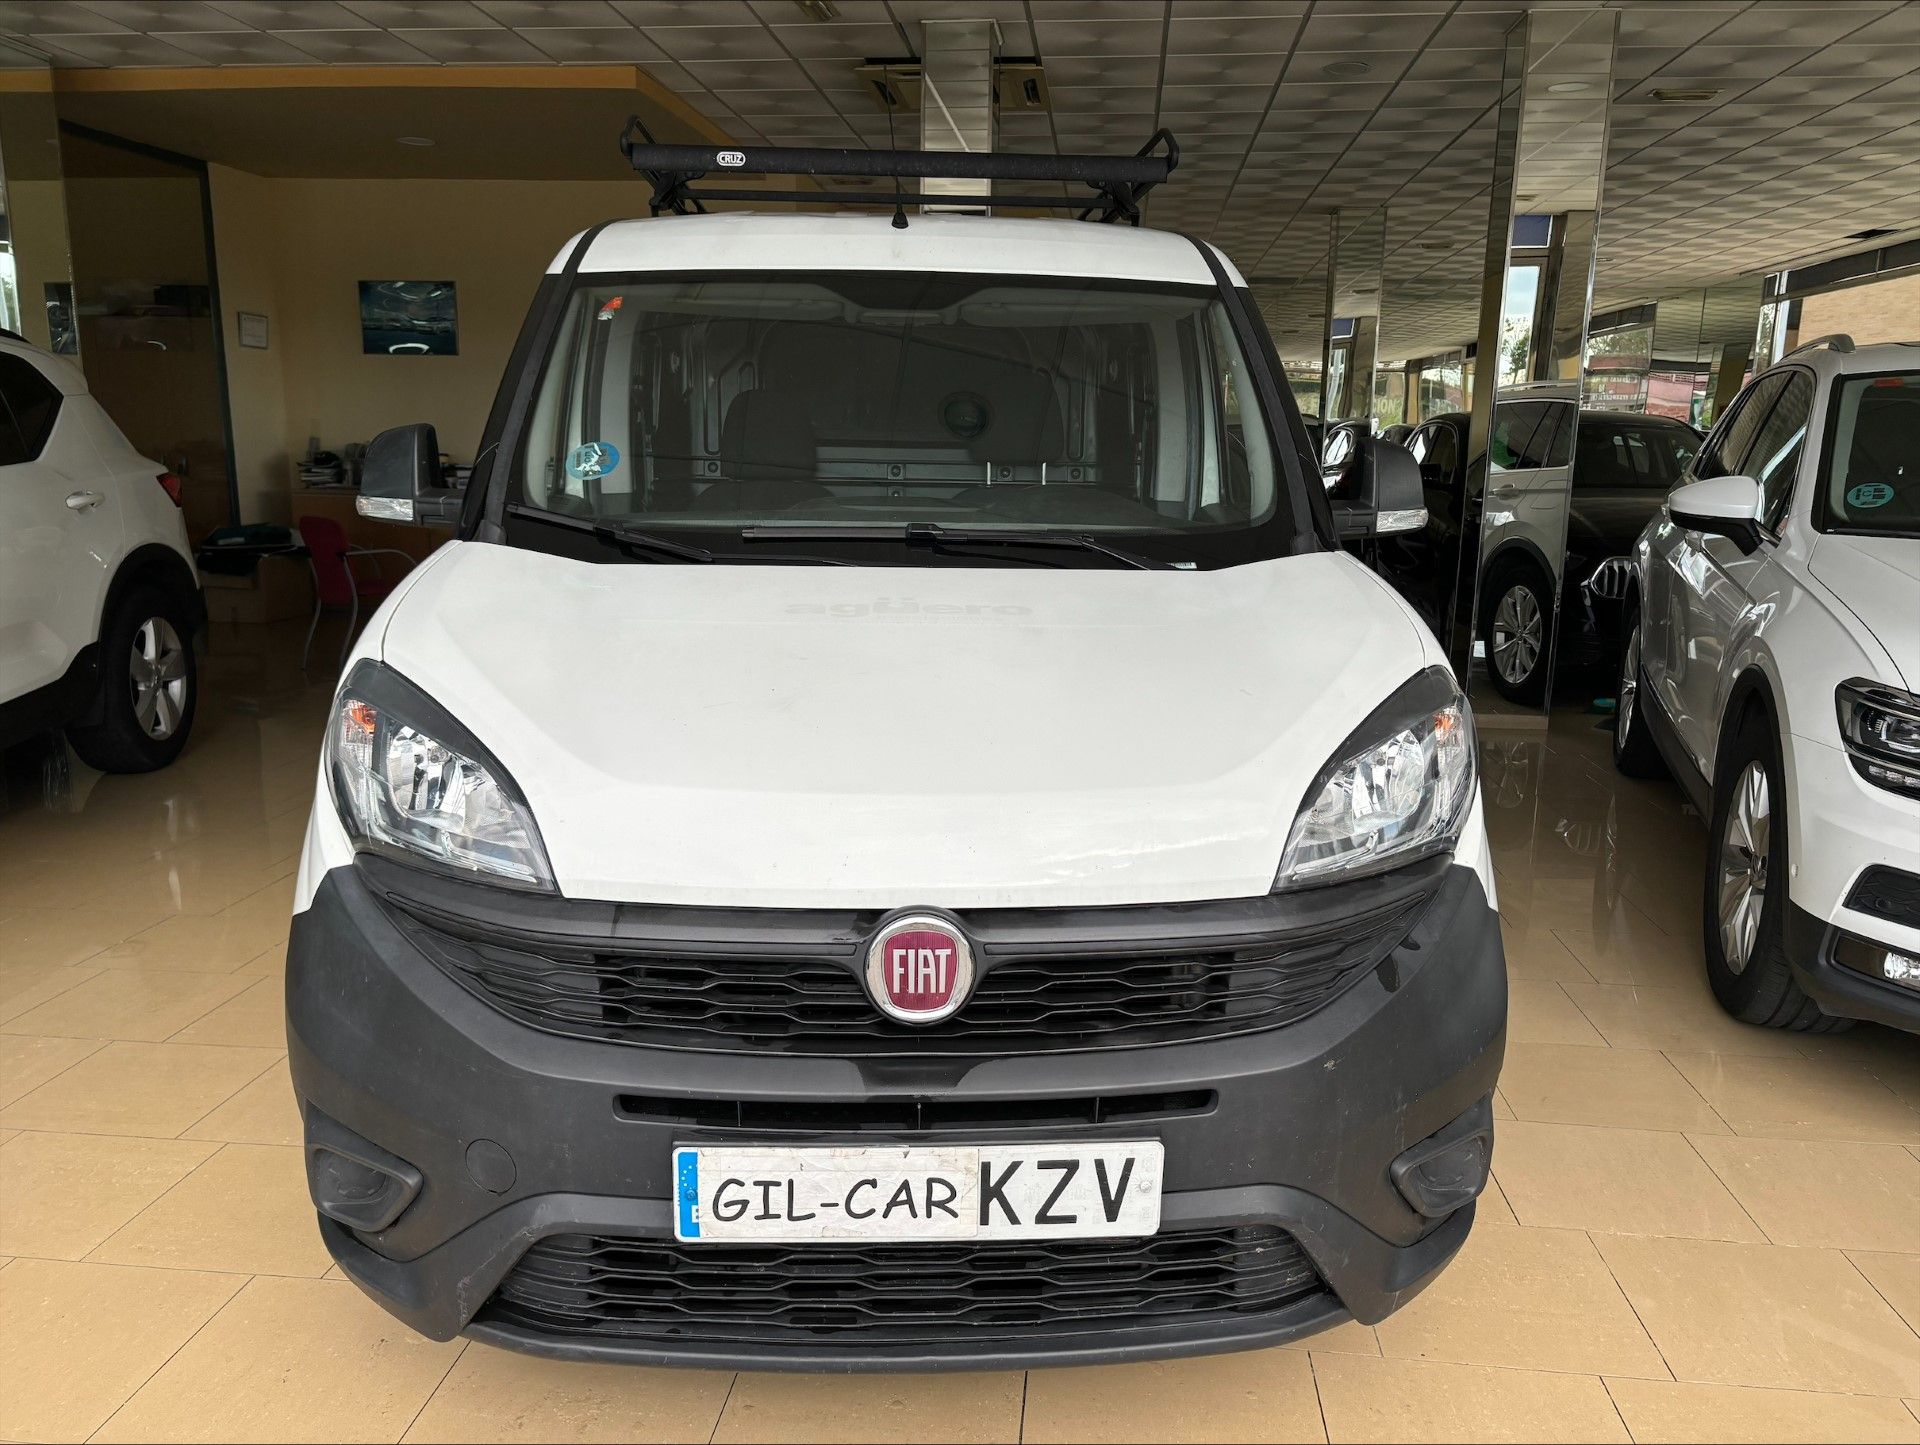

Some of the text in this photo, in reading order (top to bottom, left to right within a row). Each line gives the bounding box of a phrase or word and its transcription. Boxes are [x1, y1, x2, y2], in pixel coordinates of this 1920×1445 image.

[720, 154, 743, 163] CRUZ
[892, 948, 952, 994] FIAT
[711, 1178, 959, 1222] GIL-CAR
[980, 1157, 1136, 1226] KZV
